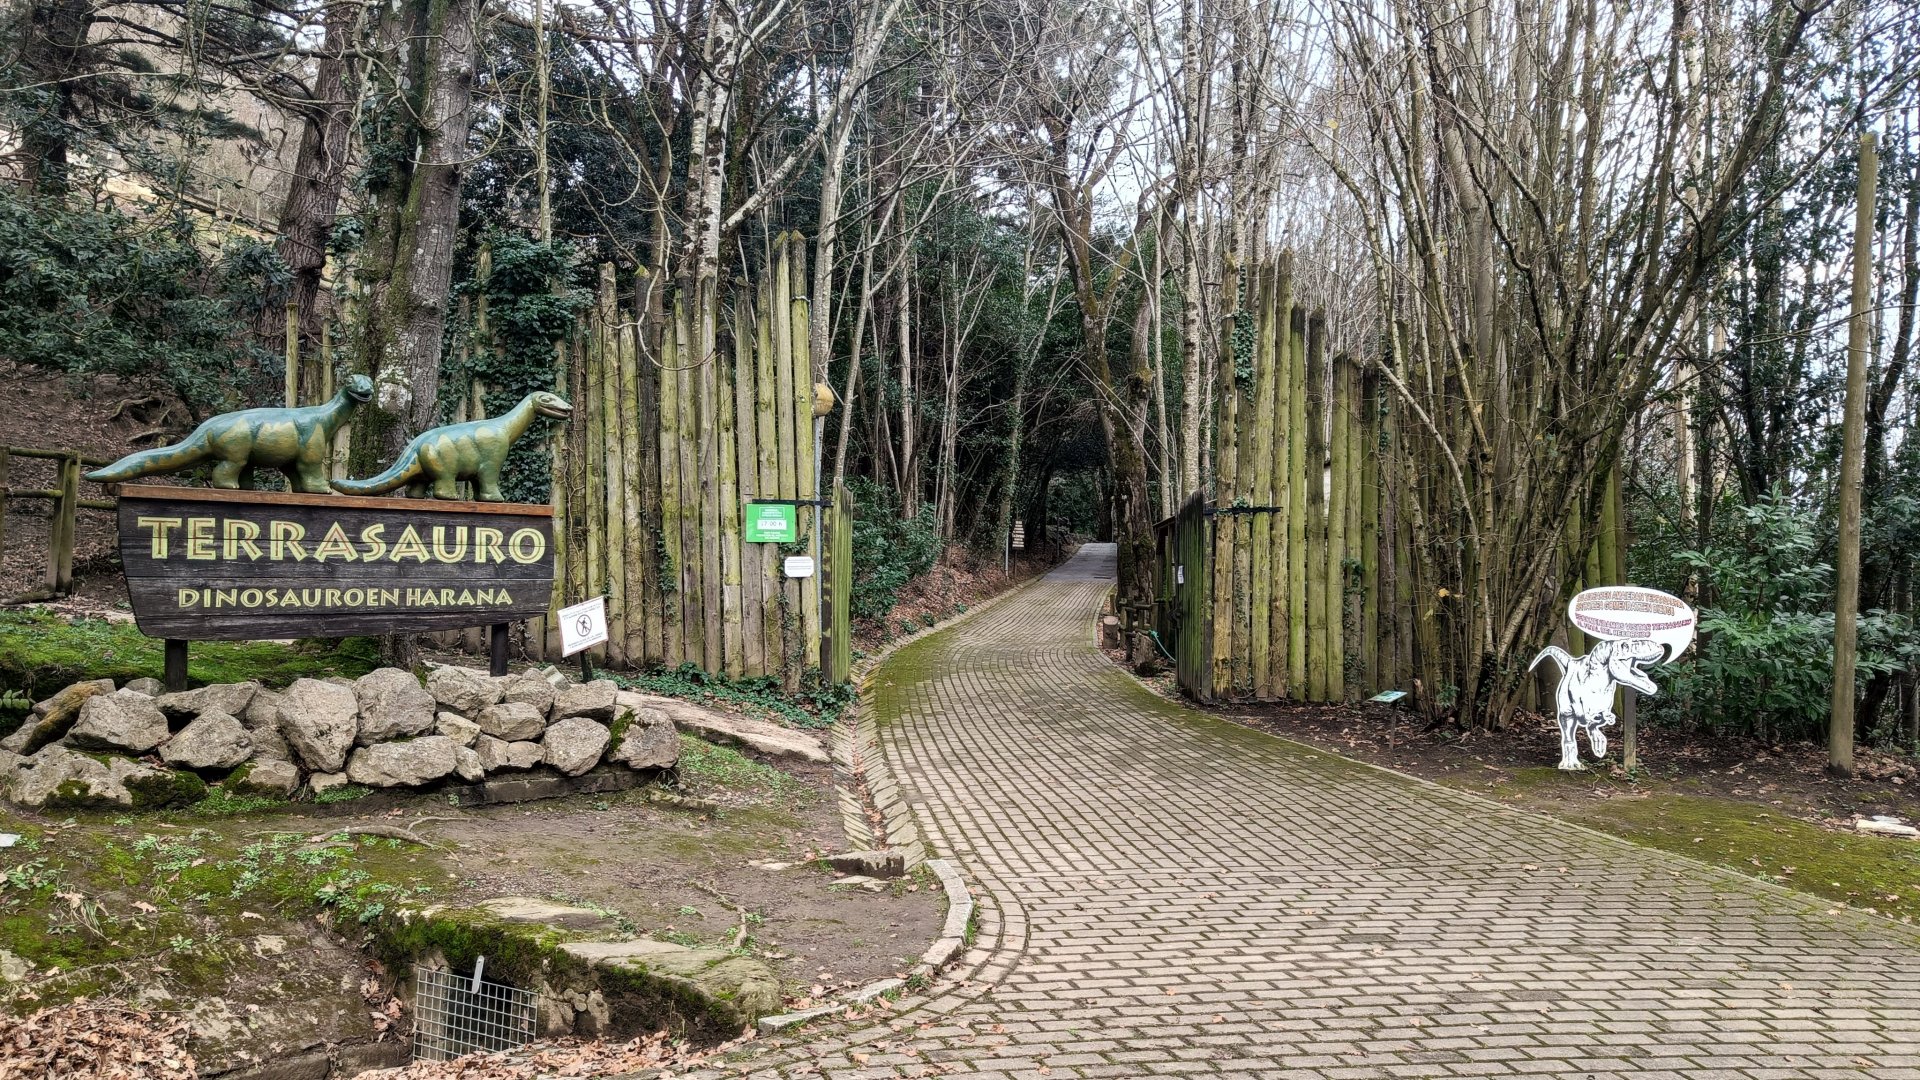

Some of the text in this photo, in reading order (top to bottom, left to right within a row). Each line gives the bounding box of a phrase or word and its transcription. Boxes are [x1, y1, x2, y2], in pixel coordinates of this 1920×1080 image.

[138, 516, 546, 564] TERRASAURO
[178, 588, 513, 608] DINOSAUROEN HARANA
